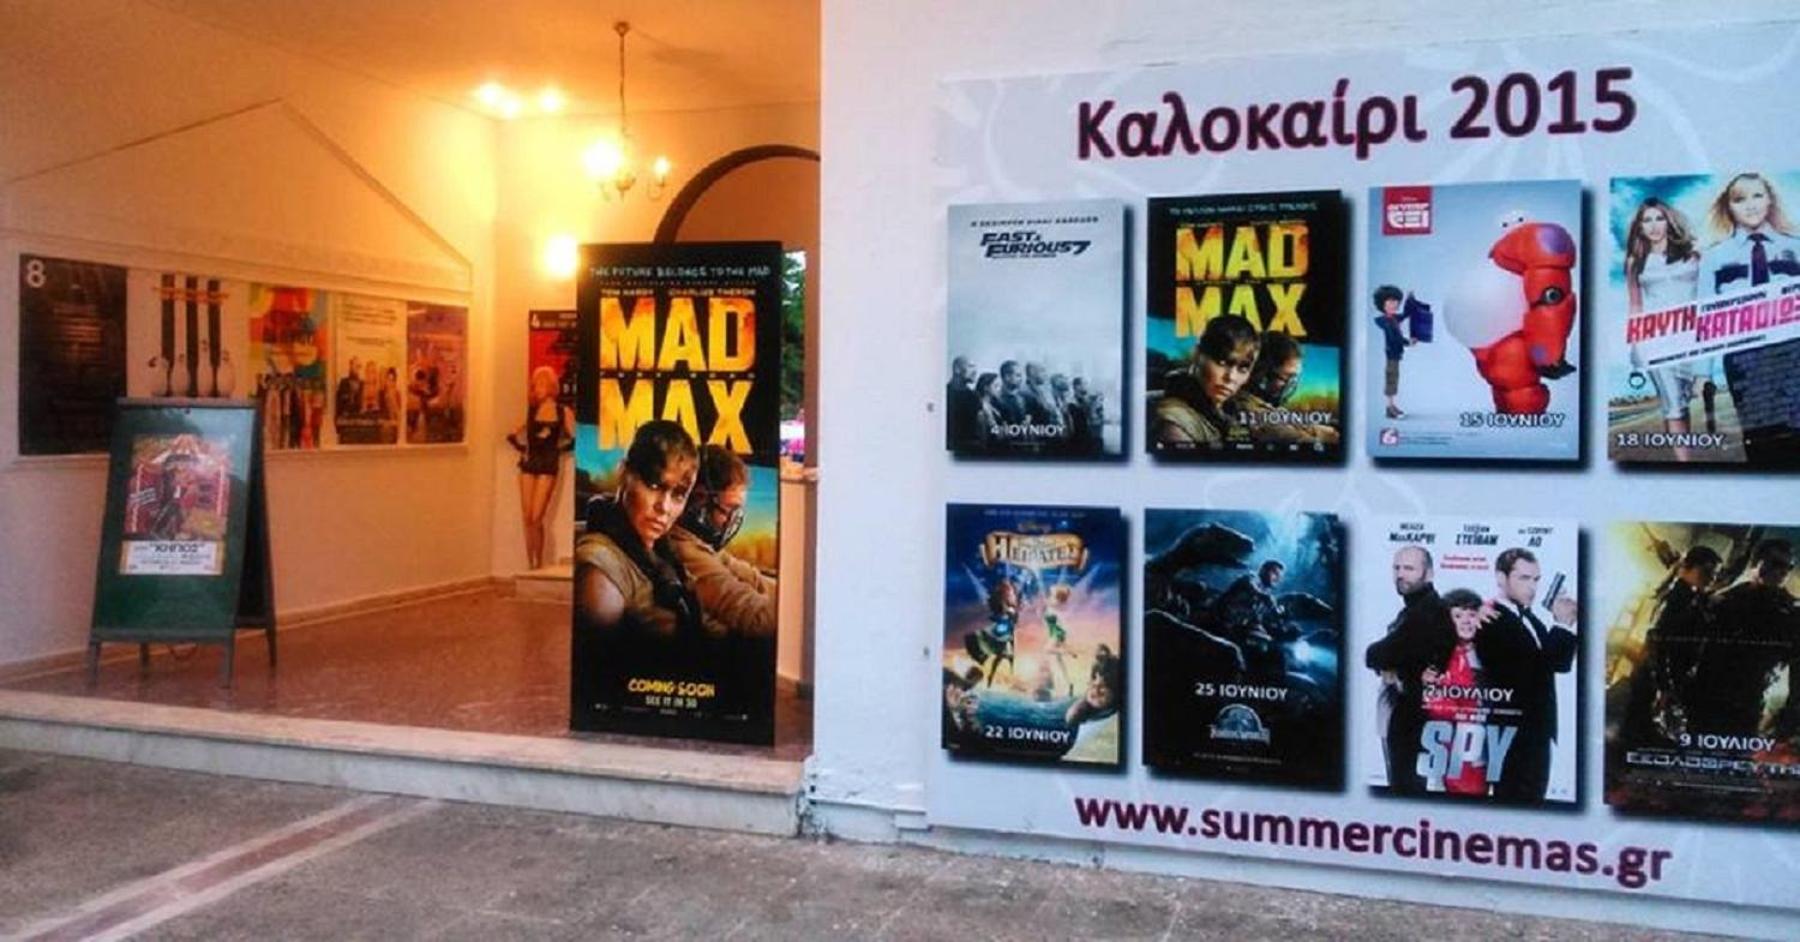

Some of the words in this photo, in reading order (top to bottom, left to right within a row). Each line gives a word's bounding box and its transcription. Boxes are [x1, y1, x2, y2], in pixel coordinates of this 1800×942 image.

[1078, 78, 1427, 160] Καλοκαίρι
[1450, 67, 1637, 139] 2015
[980, 231, 1034, 246] FAST
[1175, 223, 1309, 281] MAD
[27, 260, 46, 288] 8
[1175, 283, 1308, 338] MAX
[600, 298, 756, 372] MAD
[1627, 304, 1697, 344] ΚΑΥΤΗ
[599, 379, 754, 455] MAX
[1263, 410, 1332, 425] ΙΟΥΝΙΟΥ
[1487, 412, 1566, 428] ΙΟΥΝΙΟΥ
[1616, 433, 1639, 447] 18
[1644, 433, 1725, 448] ΙΟΥΝΙΟΥ
[628, 678, 675, 695] COMING
[678, 681, 715, 697] SOON
[1195, 683, 1216, 697] 25
[1220, 684, 1288, 701] ΙΟΥΝΙΟΥ
[1443, 685, 1515, 702] ΙΟΥΛΙΟΥ
[985, 726, 1004, 739] 22
[1008, 728, 1071, 744] ΙΟΥΝΙΟΥ
[1680, 733, 1691, 746] 9
[1698, 734, 1775, 751] ΙΟΥΛΙΟΥ
[1416, 720, 1518, 792] SPY
[1075, 797, 1672, 886] www.summercinemas.gr
